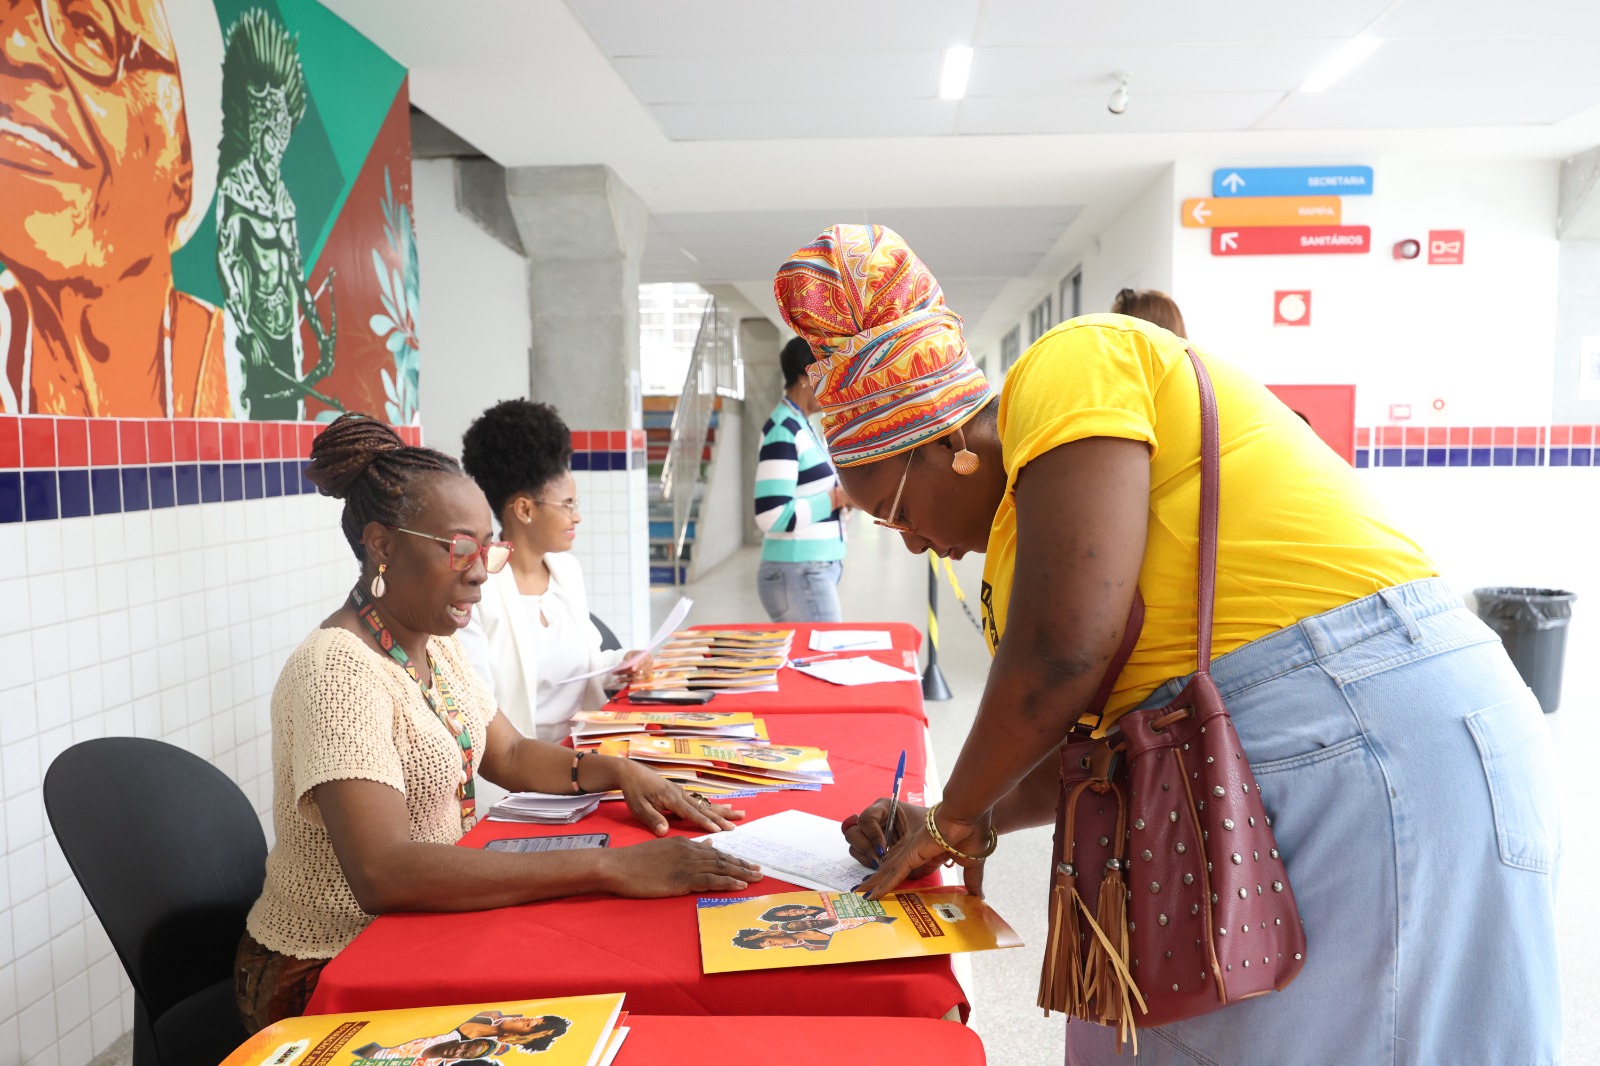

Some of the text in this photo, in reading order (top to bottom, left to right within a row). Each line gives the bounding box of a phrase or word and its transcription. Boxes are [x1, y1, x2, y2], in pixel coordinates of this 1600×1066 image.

[1307, 176, 1366, 187] SECRETARIA
[1298, 207, 1335, 216] RAMPA
[1300, 234, 1364, 247] SANITÁRIOS
